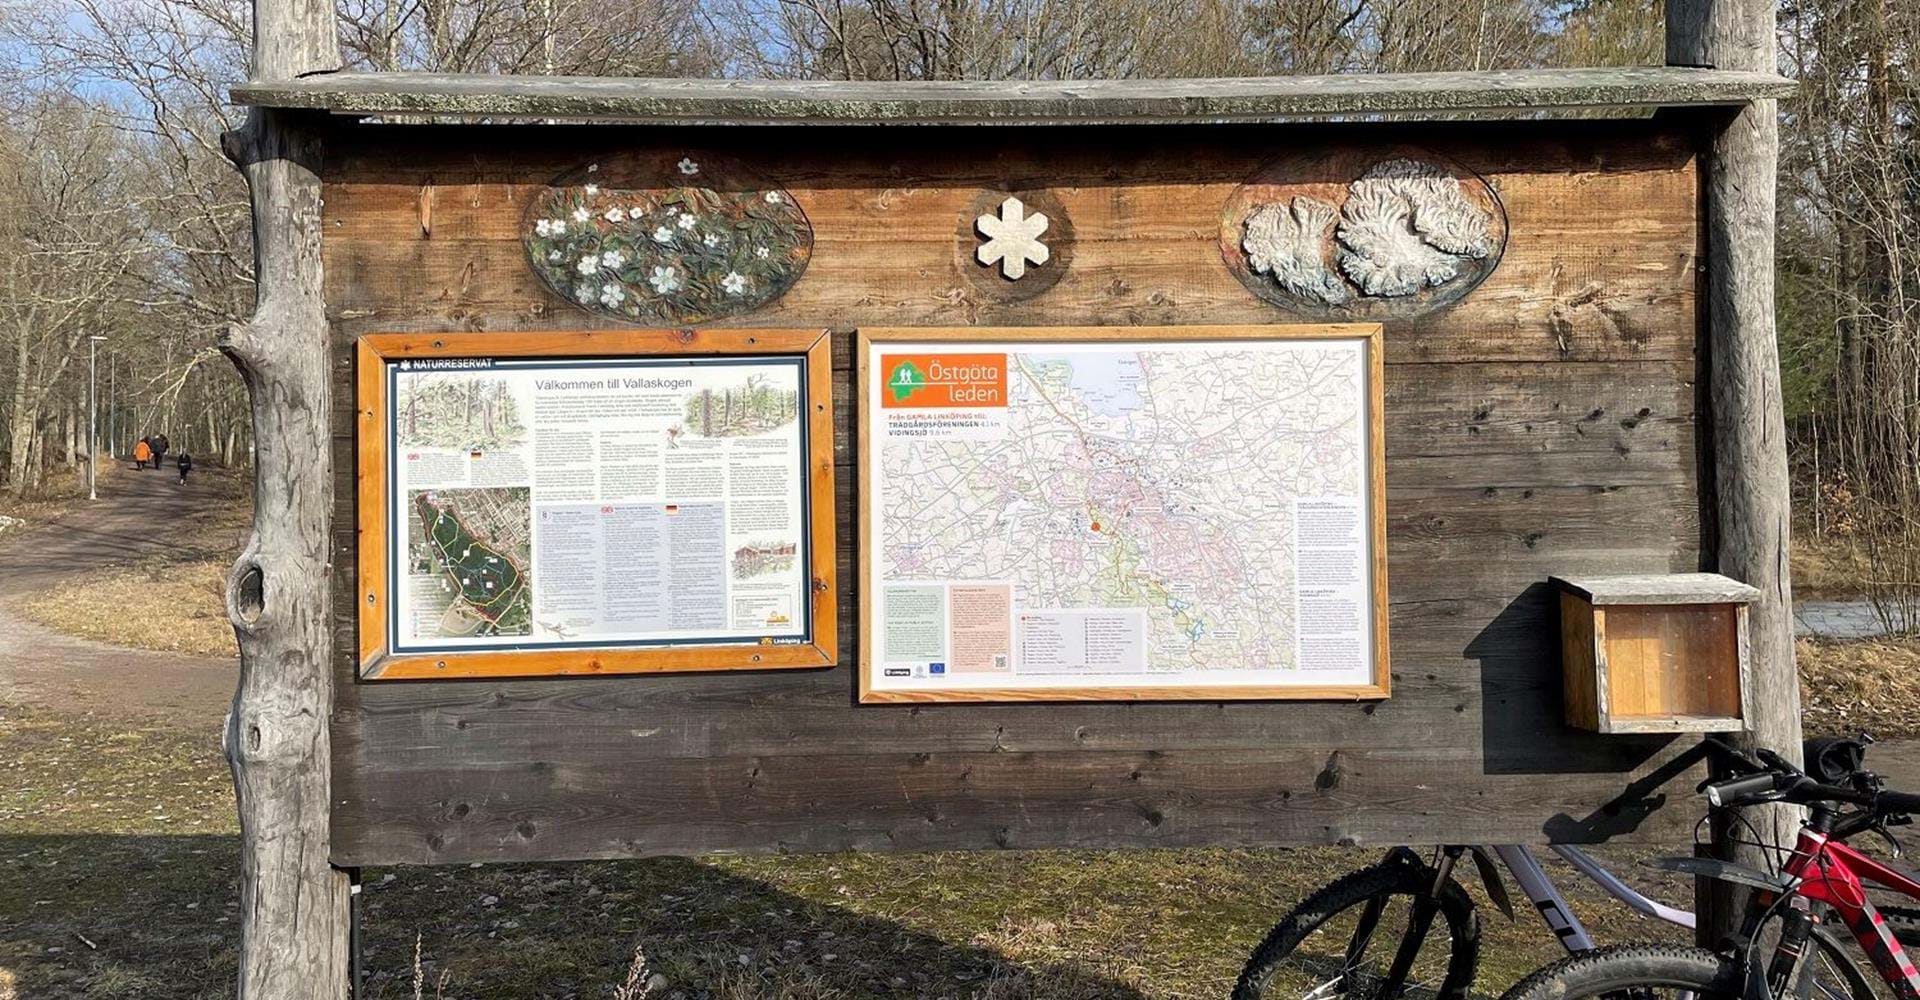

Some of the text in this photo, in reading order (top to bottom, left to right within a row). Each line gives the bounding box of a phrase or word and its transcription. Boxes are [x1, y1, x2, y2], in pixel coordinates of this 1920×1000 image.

[413, 358, 492, 369] NATURRESERVAT
[929, 360, 998, 384] Östgöta
[535, 378, 693, 390] Välkommen till Vallaskogen
[949, 384, 998, 402] leden
[933, 412, 973, 420] LINKÖPING
